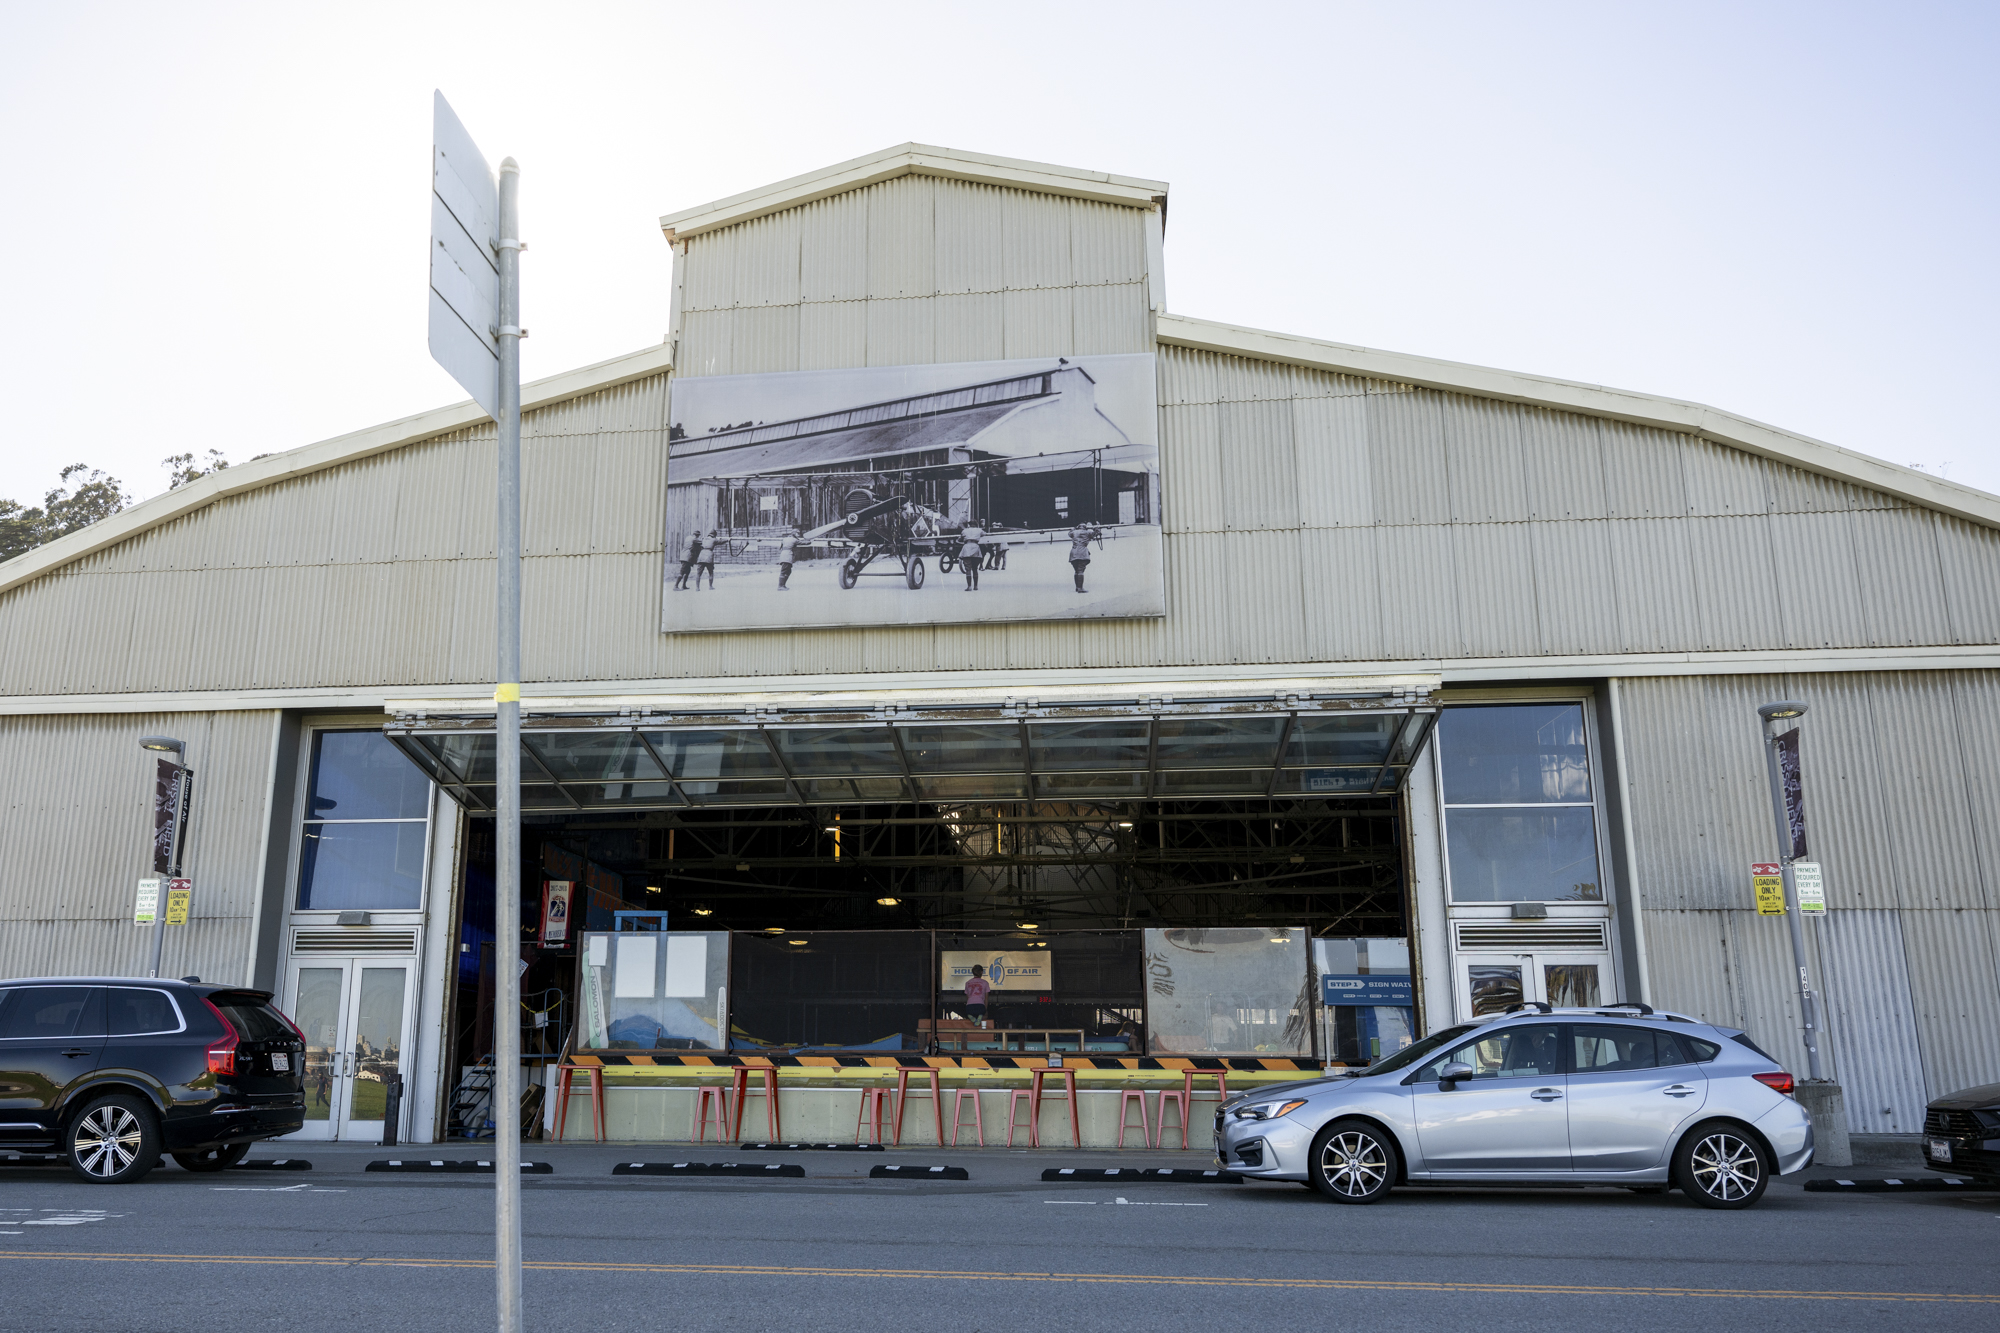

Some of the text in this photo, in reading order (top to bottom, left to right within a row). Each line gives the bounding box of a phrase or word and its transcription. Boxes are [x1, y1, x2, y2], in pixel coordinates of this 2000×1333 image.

[168, 770, 180, 815] CRISSY
[1780, 740, 1798, 838] CRISSY FIELD
[590, 976, 600, 1029] SALOMON
[968, 983, 983, 996] 73
